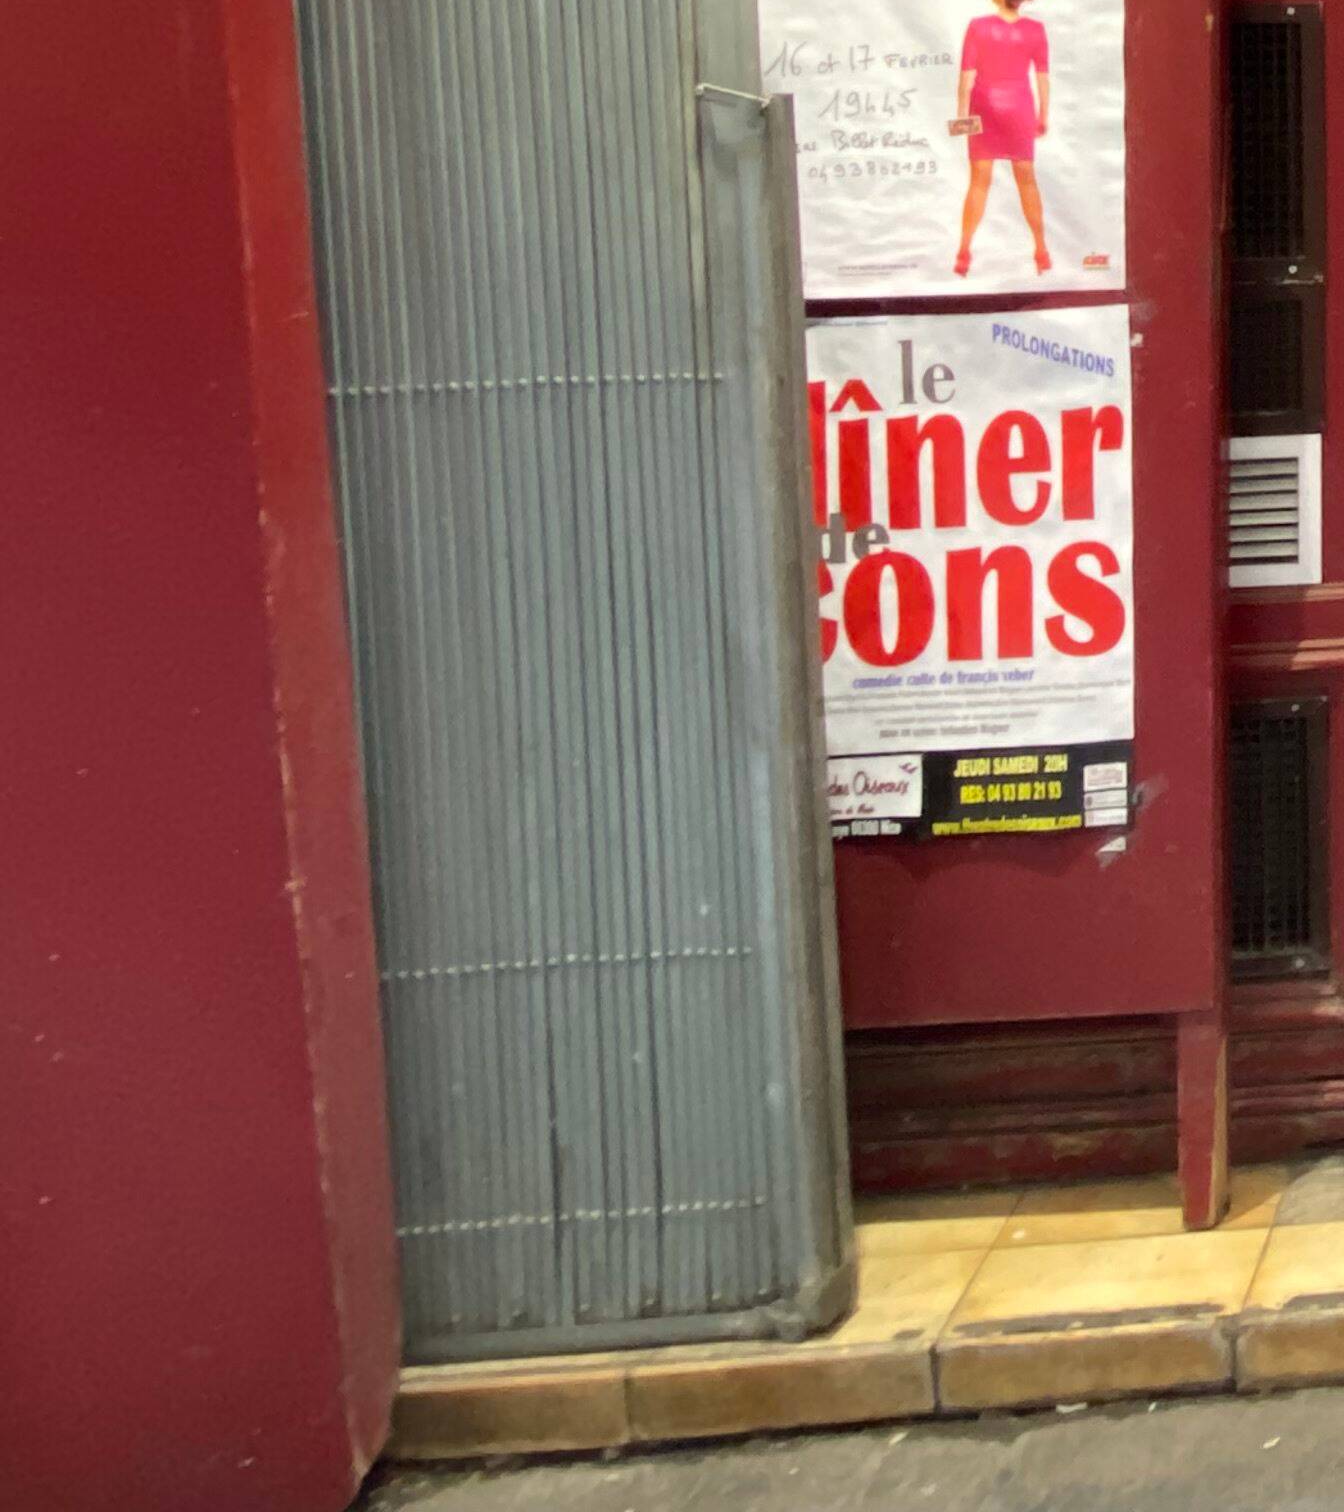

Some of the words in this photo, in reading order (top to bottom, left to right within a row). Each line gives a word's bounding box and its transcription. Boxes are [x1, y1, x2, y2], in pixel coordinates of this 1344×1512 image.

[764, 41, 807, 78] 16
[849, 44, 875, 72] 17
[898, 339, 956, 406] le
[991, 323, 1116, 378] PROLONGATIONS
[807, 379, 1125, 533] îner
[852, 770, 910, 797] Oiseaux
[953, 757, 991, 779] JEUDI
[993, 755, 1039, 776] SAMEDI
[1043, 754, 1069, 774] 20H
